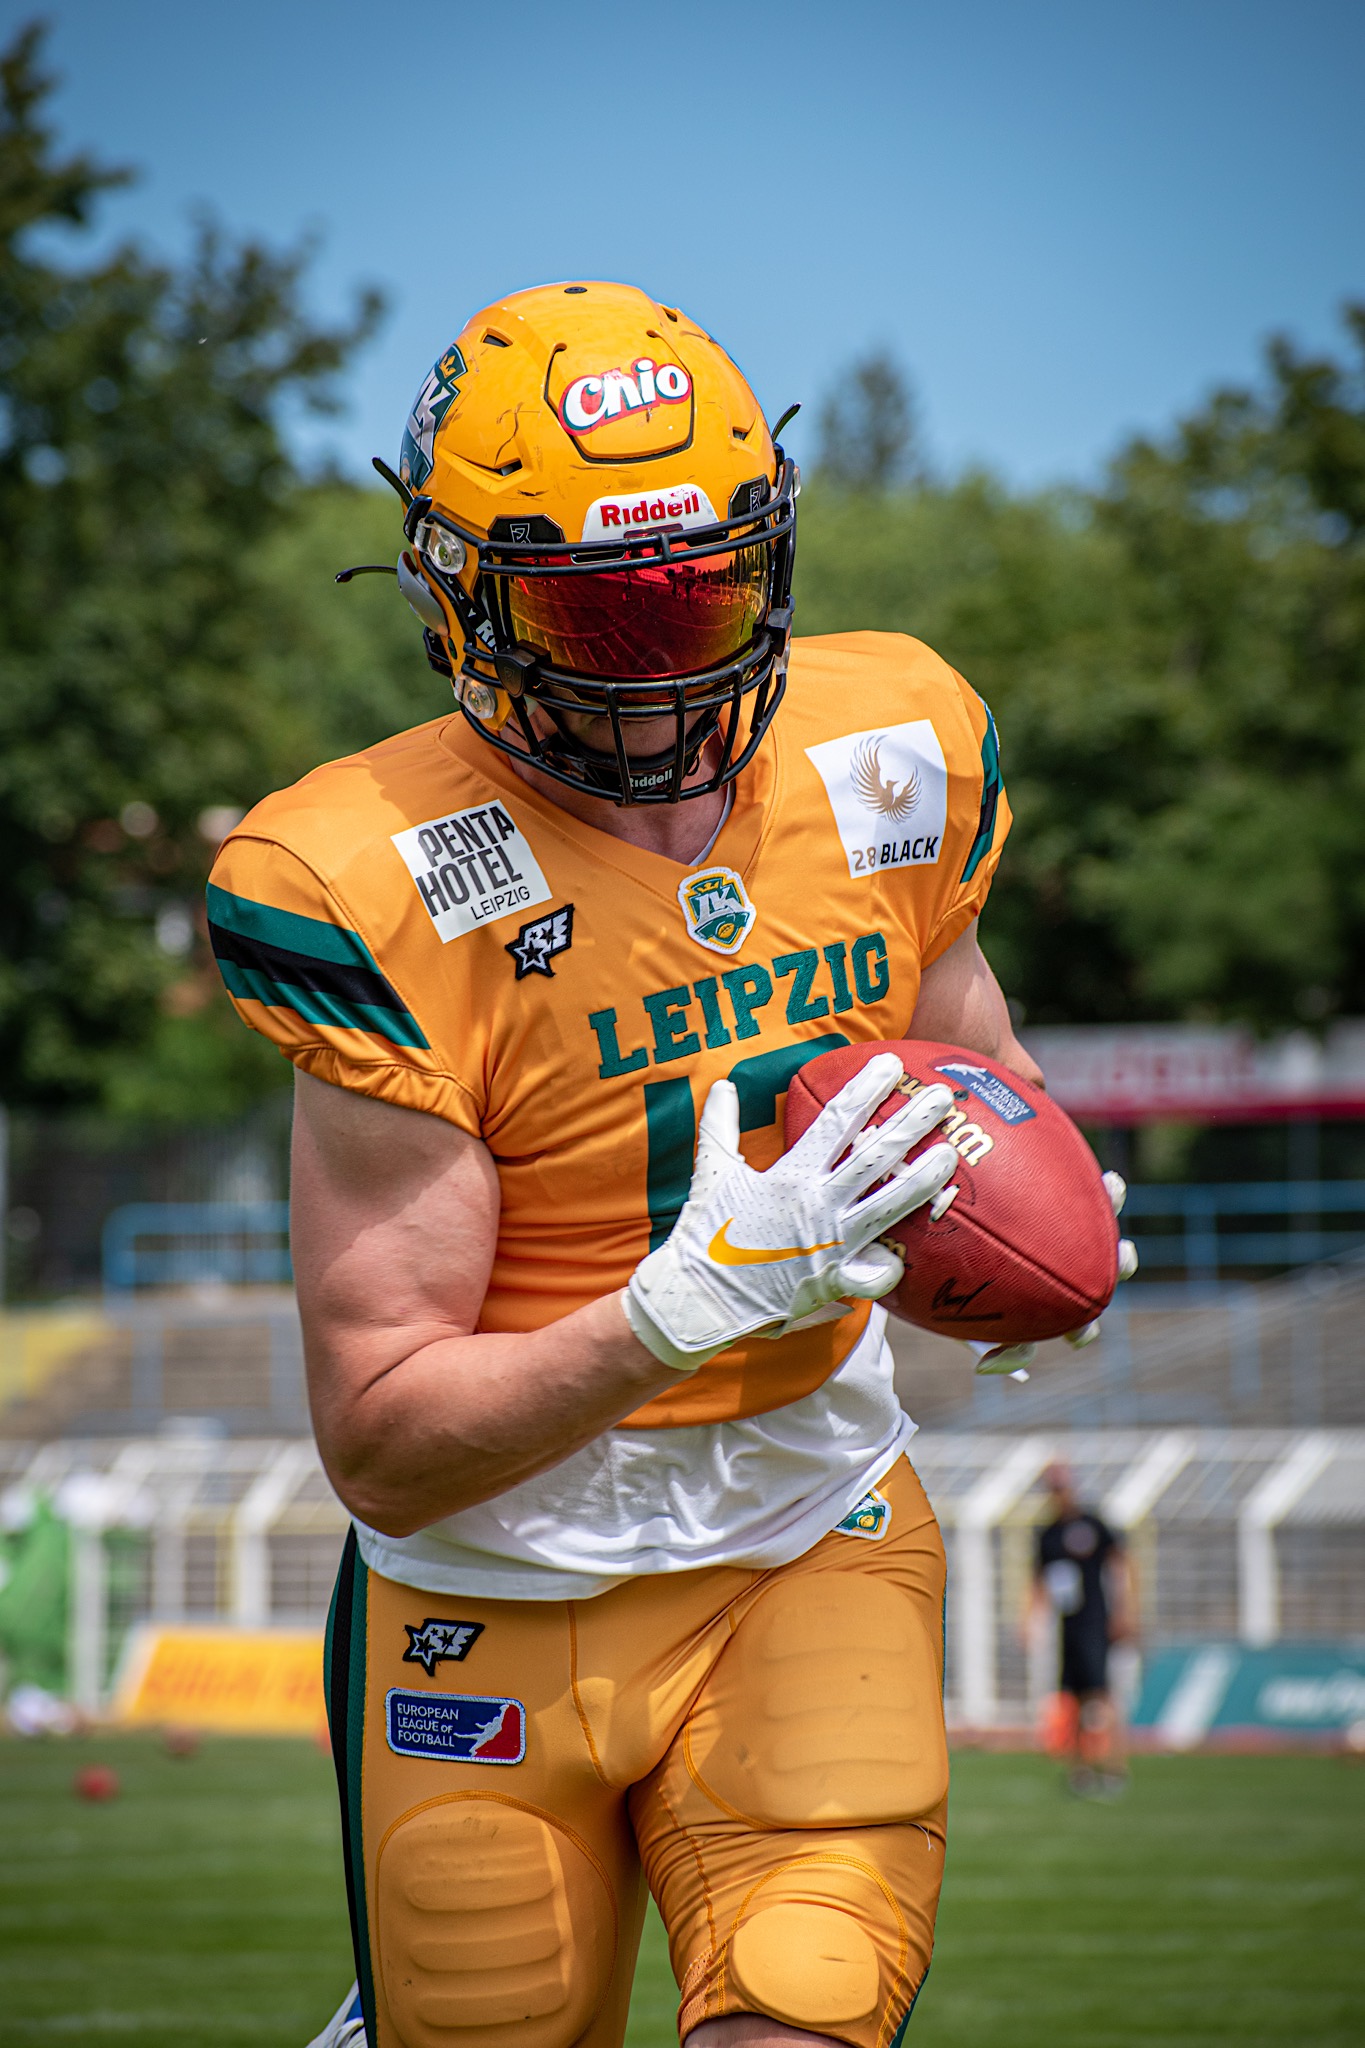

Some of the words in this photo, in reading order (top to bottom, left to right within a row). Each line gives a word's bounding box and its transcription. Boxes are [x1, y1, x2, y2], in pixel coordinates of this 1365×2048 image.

[562, 357, 690, 432] Chio
[600, 489, 700, 527] Riddell
[417, 805, 515, 868] PENTA
[852, 846, 877, 872] 28
[880, 836, 939, 865] BLACK
[415, 844, 523, 918] HOTEL
[470, 885, 531, 920] LEIPZIG
[588, 931, 890, 1079] LEIPZIG
[396, 1702, 460, 1721] EUROPEAN
[397, 1716, 439, 1733] LEAGUE
[397, 1729, 456, 1748] FOOTBALL
